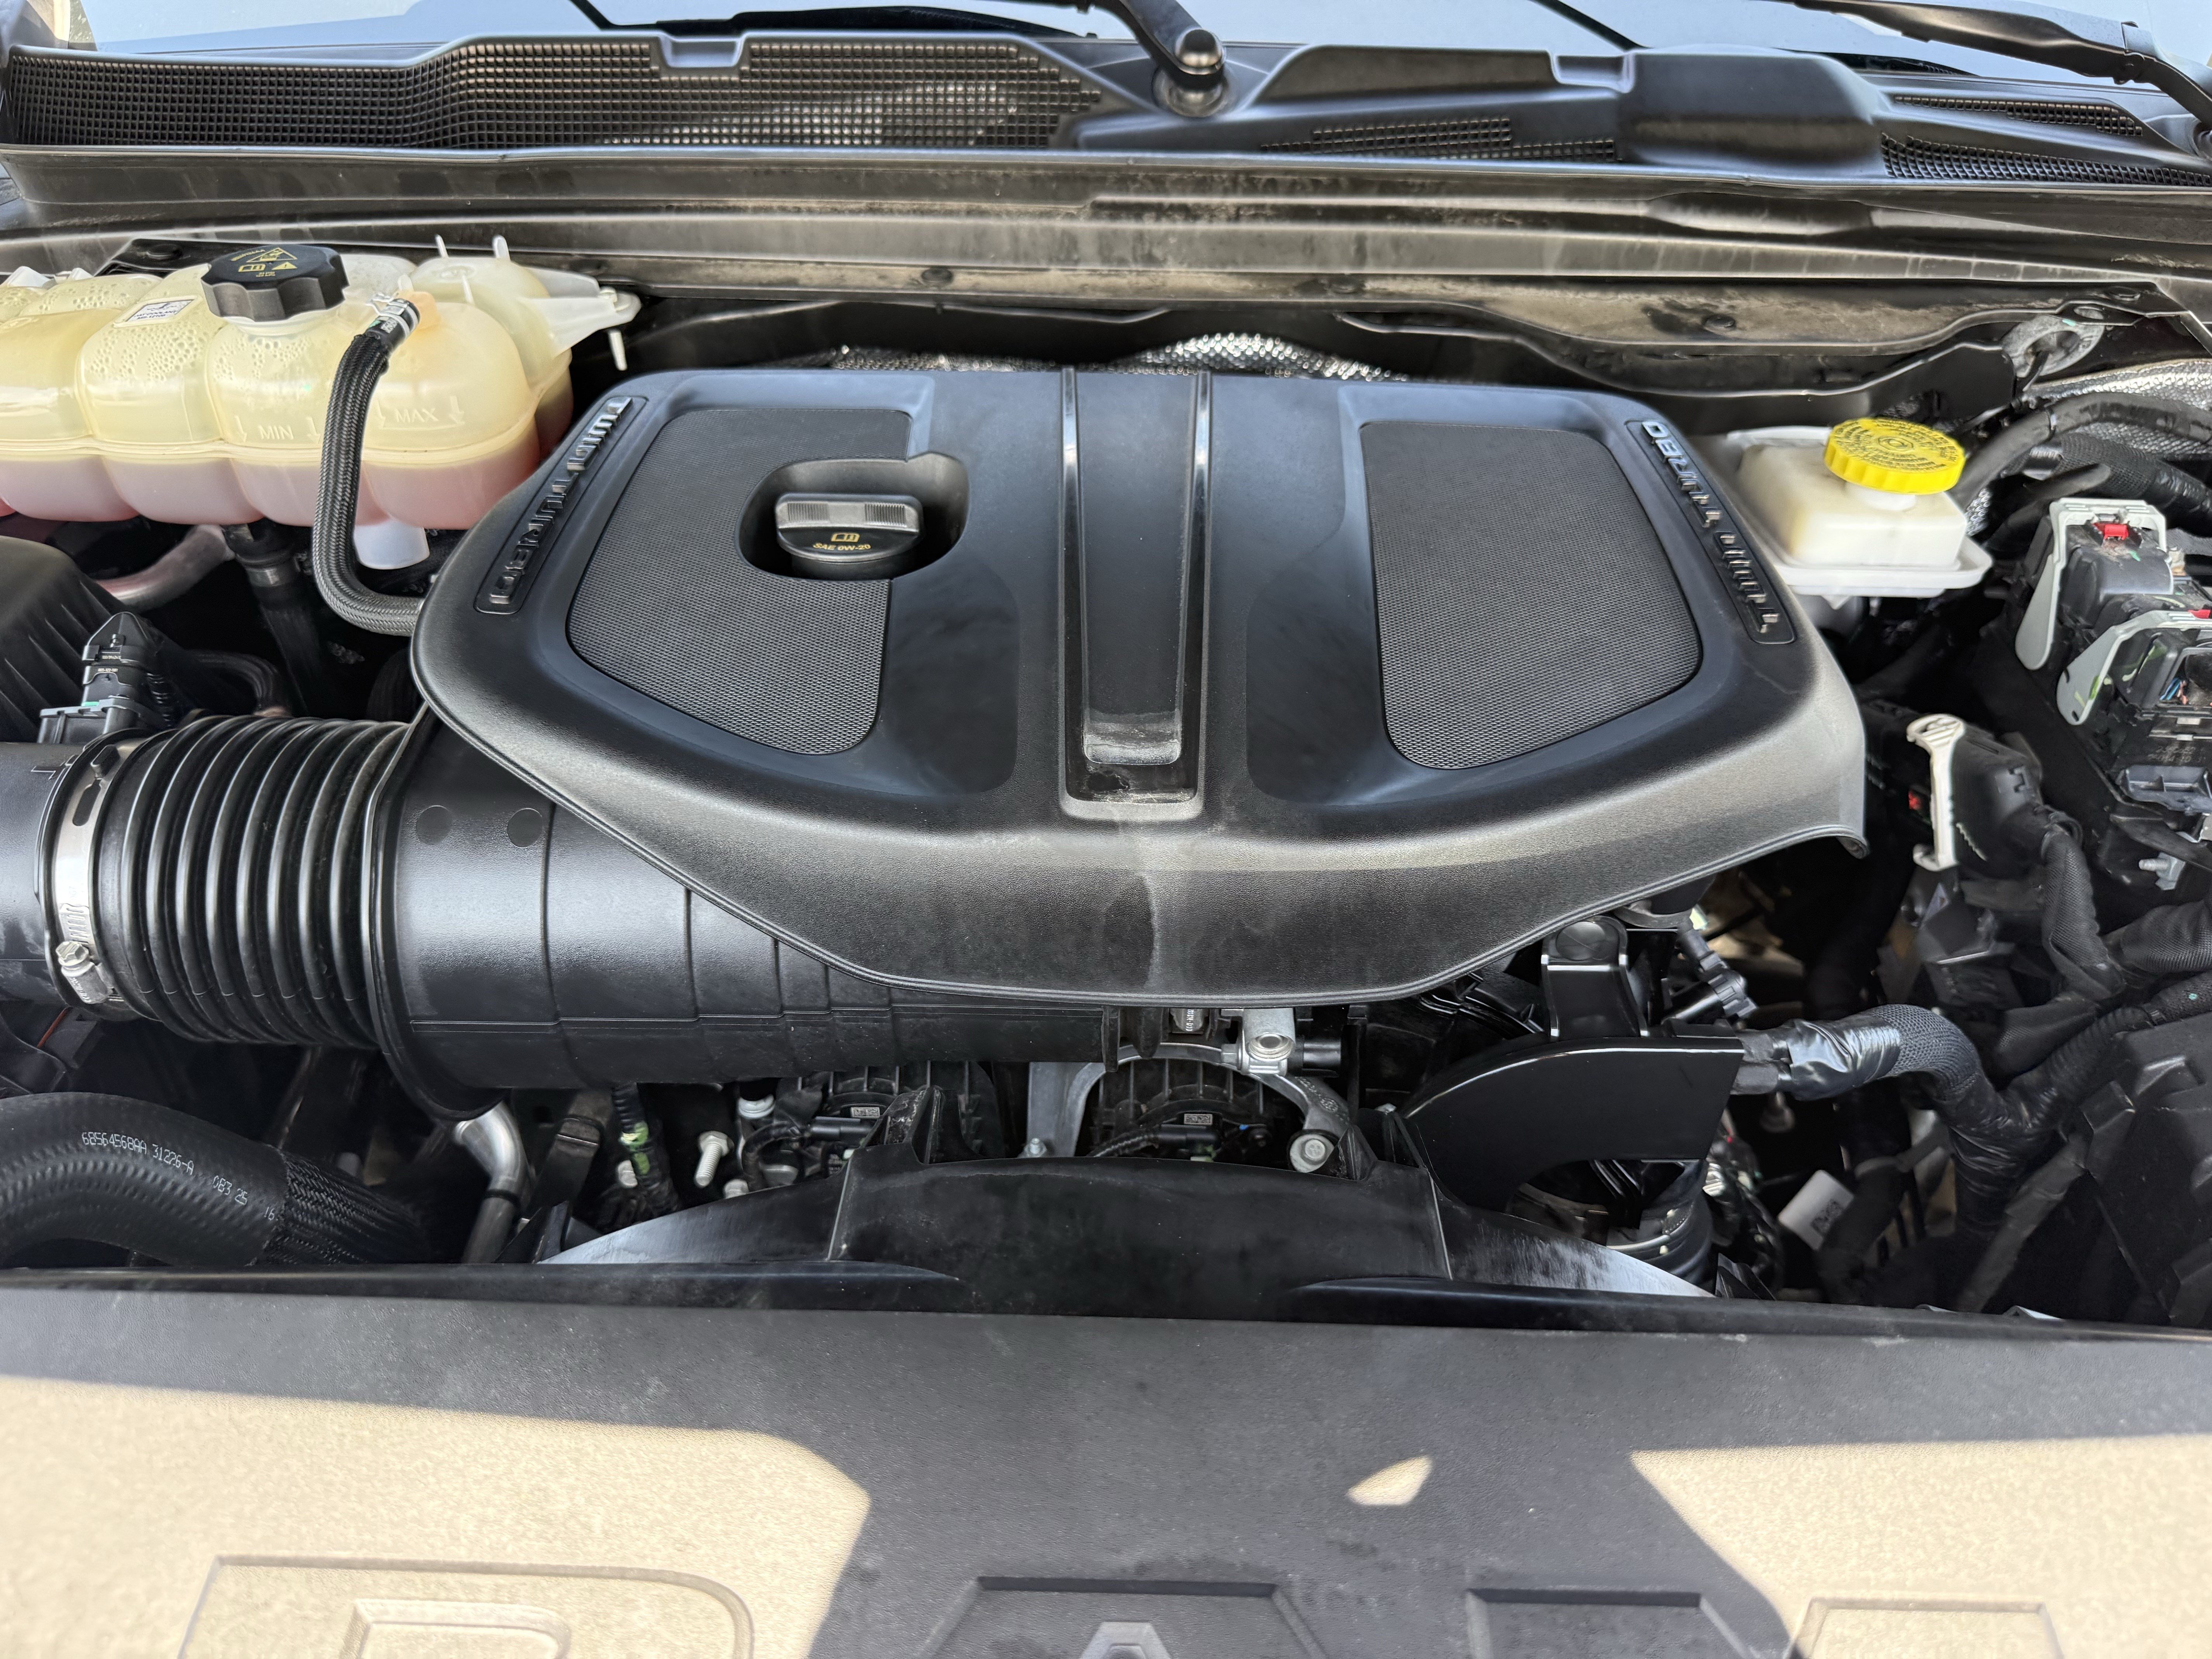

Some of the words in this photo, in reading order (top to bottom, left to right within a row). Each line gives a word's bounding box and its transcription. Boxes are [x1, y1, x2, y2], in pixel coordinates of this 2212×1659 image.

[395, 408, 439, 423] MAX
[258, 425, 294, 440] MIN
[1641, 421, 1722, 528] TURBO
[488, 472, 579, 605] TURBO
[82, 1132, 147, 1154] 68564568AA
